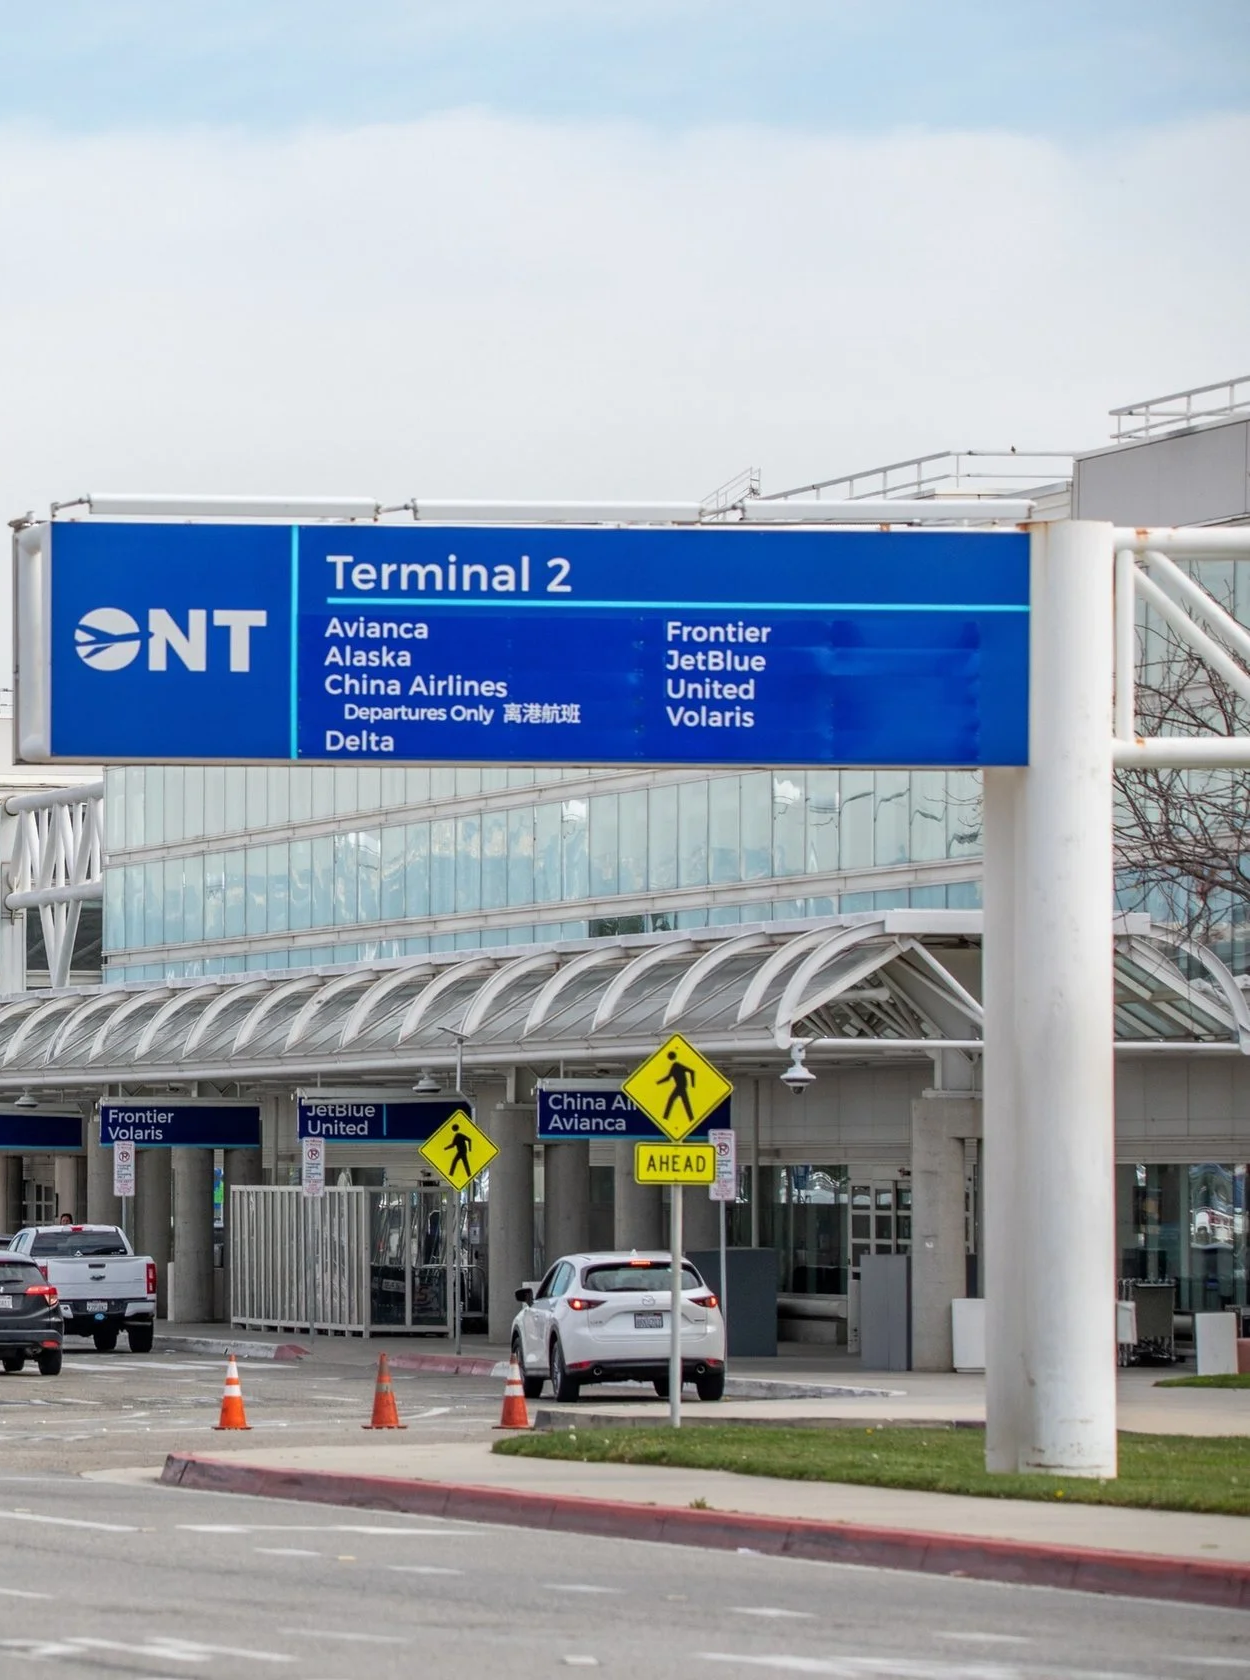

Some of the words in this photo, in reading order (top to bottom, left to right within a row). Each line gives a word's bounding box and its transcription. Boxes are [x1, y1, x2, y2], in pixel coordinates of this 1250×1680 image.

[325, 554, 530, 592] Terminal
[546, 557, 573, 593] 2
[324, 616, 429, 639] Avianca
[667, 621, 772, 643] Frontier
[74, 607, 268, 673] ONT
[324, 645, 412, 668] Alaska
[666, 649, 767, 672] JetBlue
[324, 674, 401, 696] China
[409, 675, 508, 698] Airlines
[667, 677, 755, 700] United
[344, 703, 447, 724] Departures
[450, 704, 495, 726] Only
[503, 703, 582, 724] 离港航班
[666, 705, 755, 728] Volaris
[325, 730, 395, 752] Delta
[307, 1104, 376, 1117] JetBlue
[548, 1093, 607, 1111] China
[109, 1109, 174, 1123] Frontier
[308, 1119, 368, 1135] United
[548, 1114, 626, 1131] Avianca
[108, 1125, 163, 1140] Volaris
[647, 1154, 706, 1173] AHEAD
